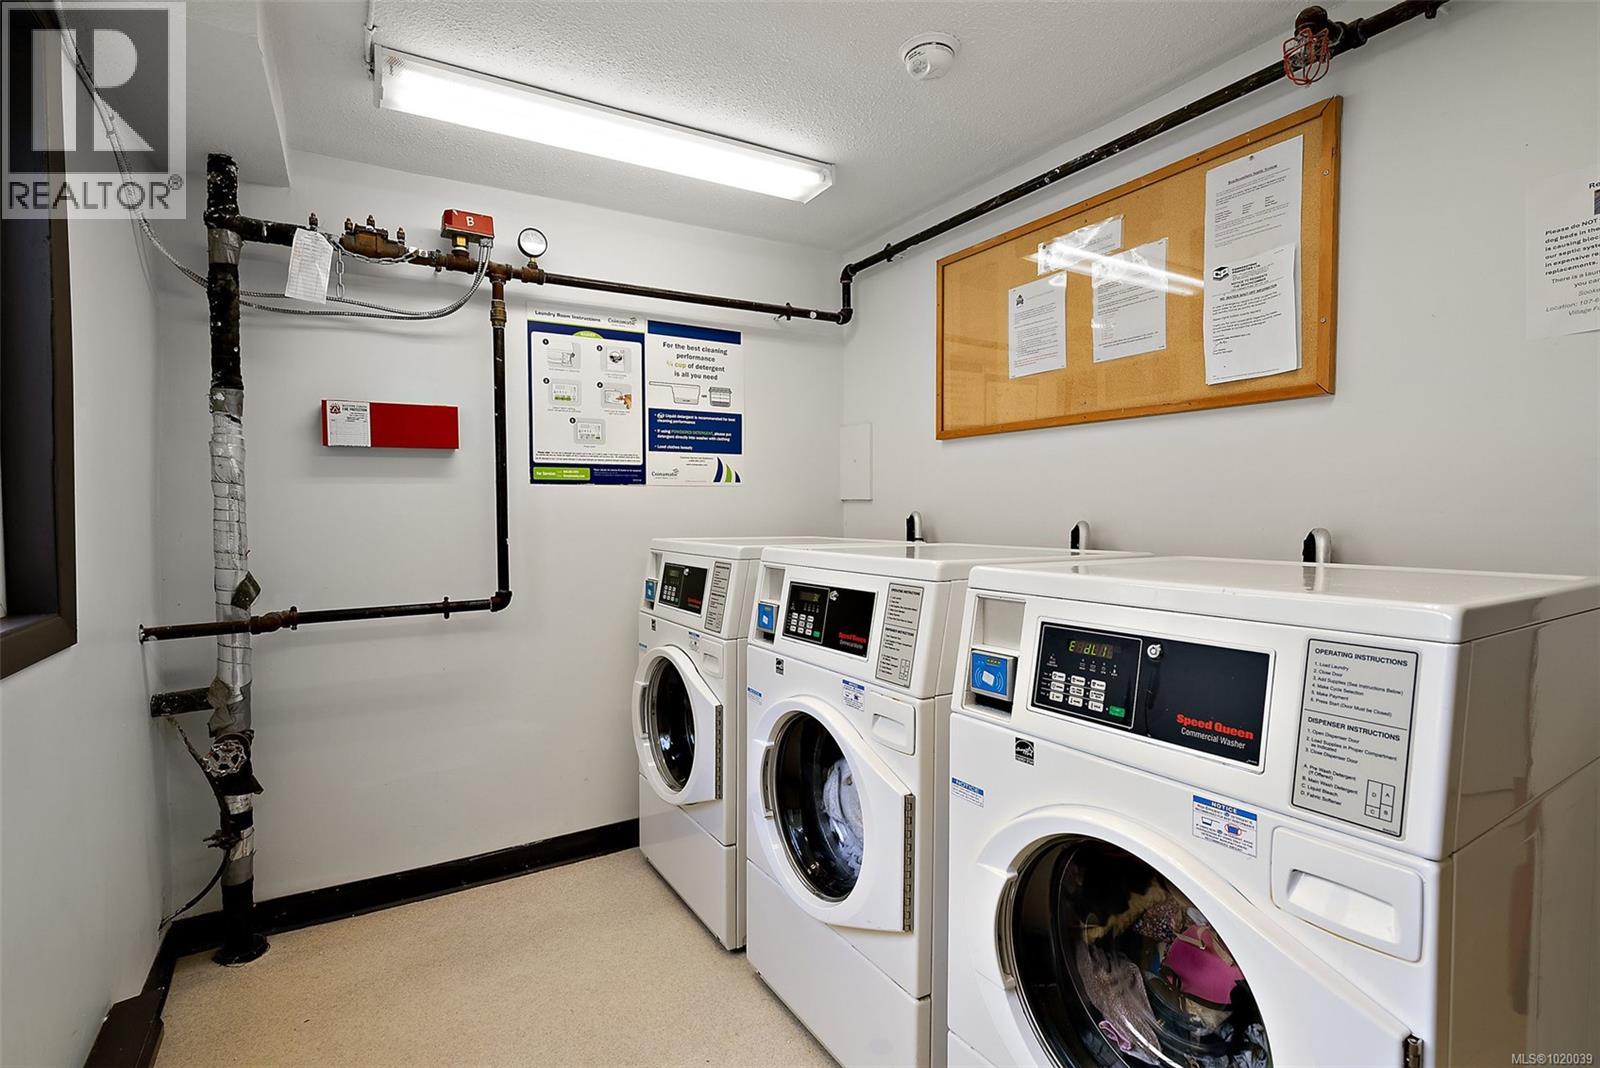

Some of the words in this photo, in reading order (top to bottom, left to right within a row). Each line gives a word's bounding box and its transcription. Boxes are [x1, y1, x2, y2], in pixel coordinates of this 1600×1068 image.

[465, 216, 475, 227] B
[1545, 226, 1569, 235] Please
[1582, 218, 1598, 226] NOT
[1553, 239, 1581, 249] causing
[1559, 247, 1581, 256] septic
[1553, 254, 1590, 265] expensive
[1545, 261, 1598, 275] replacements.
[1551, 276, 1571, 284] There
[1545, 302, 1578, 312] Location:
[1568, 308, 1592, 316] Village
[534, 310, 556, 318] Laundry
[572, 314, 601, 322] Instructions
[701, 346, 728, 356] cleaning
[676, 353, 715, 362] performance
[695, 364, 725, 372] detergent
[1315, 648, 1353, 659] OPERATING
[1354, 654, 1408, 667] INSTRUCTIONS
[1327, 678, 1346, 686] Supplies
[1359, 684, 1385, 692] Instructions
[1386, 687, 1404, 696] Below)
[1343, 688, 1364, 696] Selection
[1329, 693, 1349, 701] Payment
[1373, 709, 1392, 717] Closed)
[1176, 713, 1213, 730] Speed
[1214, 722, 1254, 740] Queen
[1308, 717, 1346, 730] DISPENSER
[1347, 725, 1400, 741] INSTRUCTIONS
[1181, 727, 1219, 742] Commercial
[1219, 736, 1246, 749] Washer
[1325, 732, 1347, 741] Dispenser
[1317, 743, 1337, 752] Indicated
[1323, 740, 1342, 749] Supplies
[1348, 745, 1363, 753] Proper
[1364, 749, 1397, 761] Compartment
[1323, 752, 1346, 761] Dispenser
[1314, 771, 1333, 781] Offered)
[1332, 770, 1356, 780] Detergent
[1307, 784, 1321, 792] Liquid
[1322, 789, 1338, 797] Bleach
[1320, 780, 1333, 788] Wash
[1334, 783, 1358, 794] Detergent
[1306, 791, 1321, 799] Fabric
[1322, 796, 1342, 805] Softener
[1211, 801, 1238, 814] NOTICE
